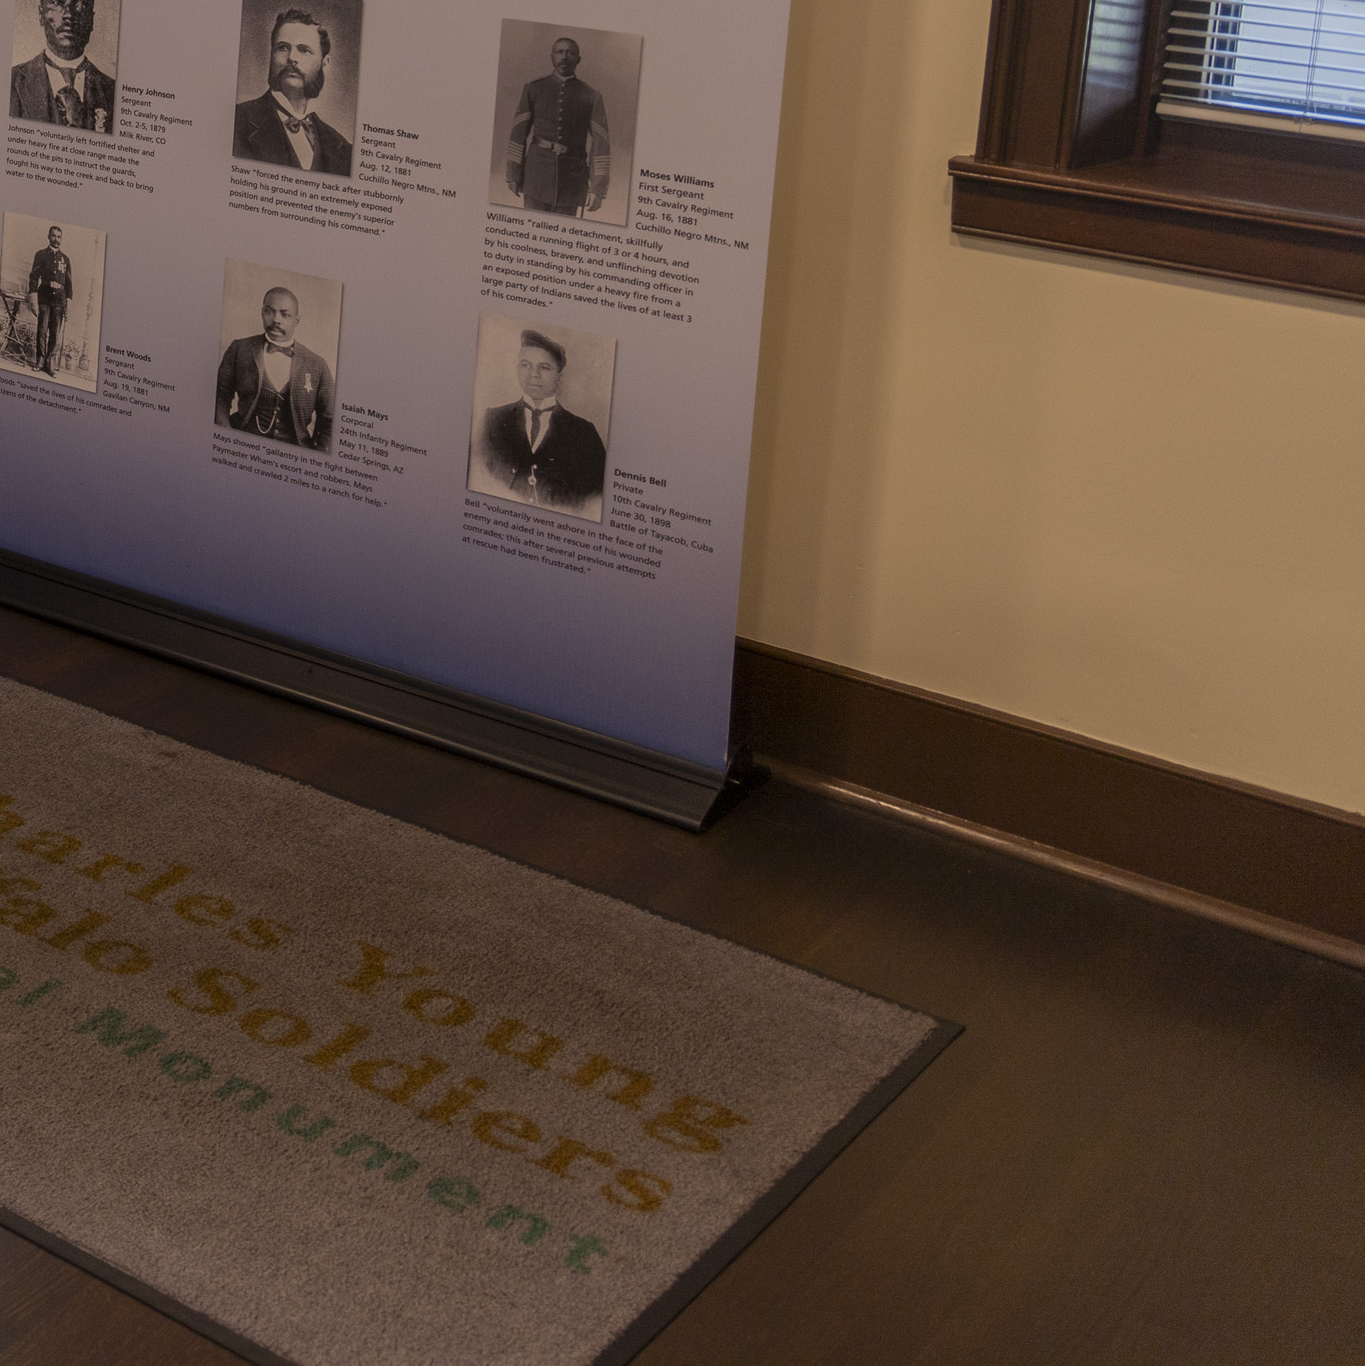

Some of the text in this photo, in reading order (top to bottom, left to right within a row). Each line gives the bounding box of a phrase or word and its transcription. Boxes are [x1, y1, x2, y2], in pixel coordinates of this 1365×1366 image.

[639, 168, 715, 189] Moses Williams
[76, 1006, 611, 1276] Monument
[168, 967, 675, 1214] Soldiers
[335, 940, 752, 1154] Young
